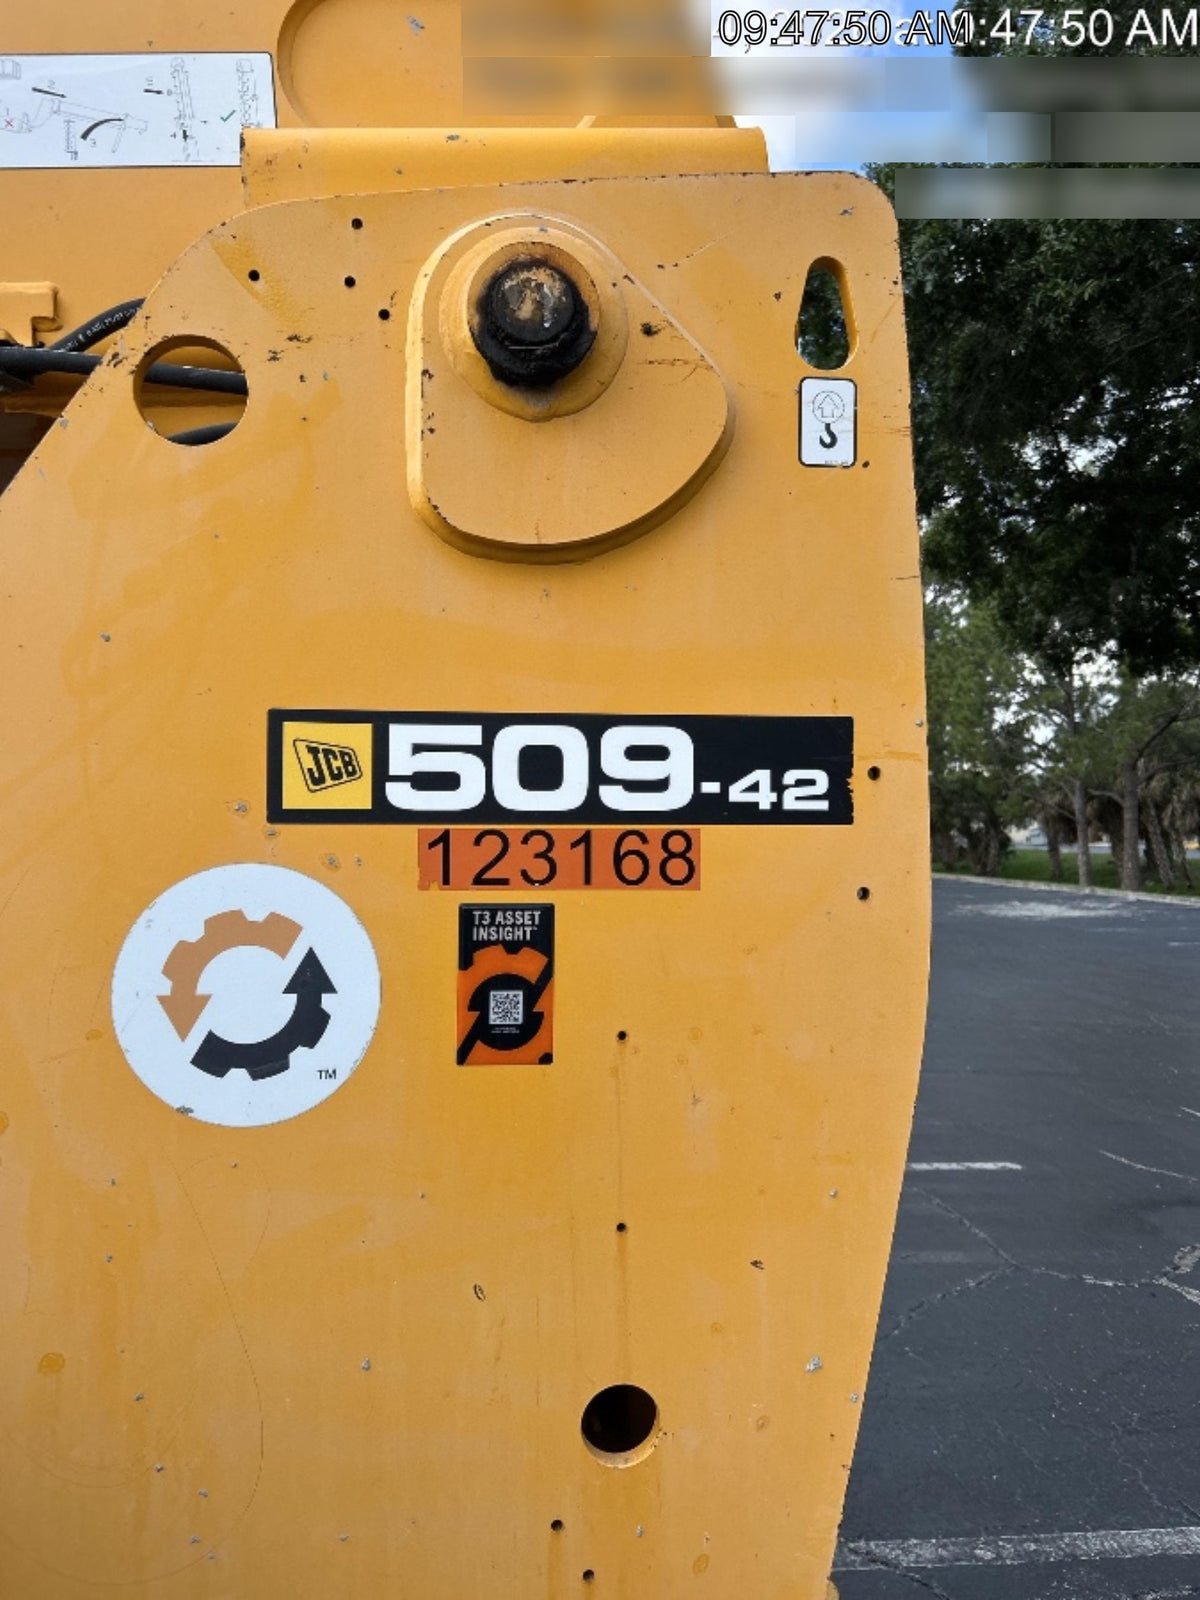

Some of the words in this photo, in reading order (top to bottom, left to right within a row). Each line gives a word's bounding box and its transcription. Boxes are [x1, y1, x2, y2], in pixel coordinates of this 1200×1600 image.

[305, 745, 358, 786] JCB
[426, 829, 695, 887] 123168
[472, 911, 490, 925] T3
[495, 911, 541, 925] ASSET
